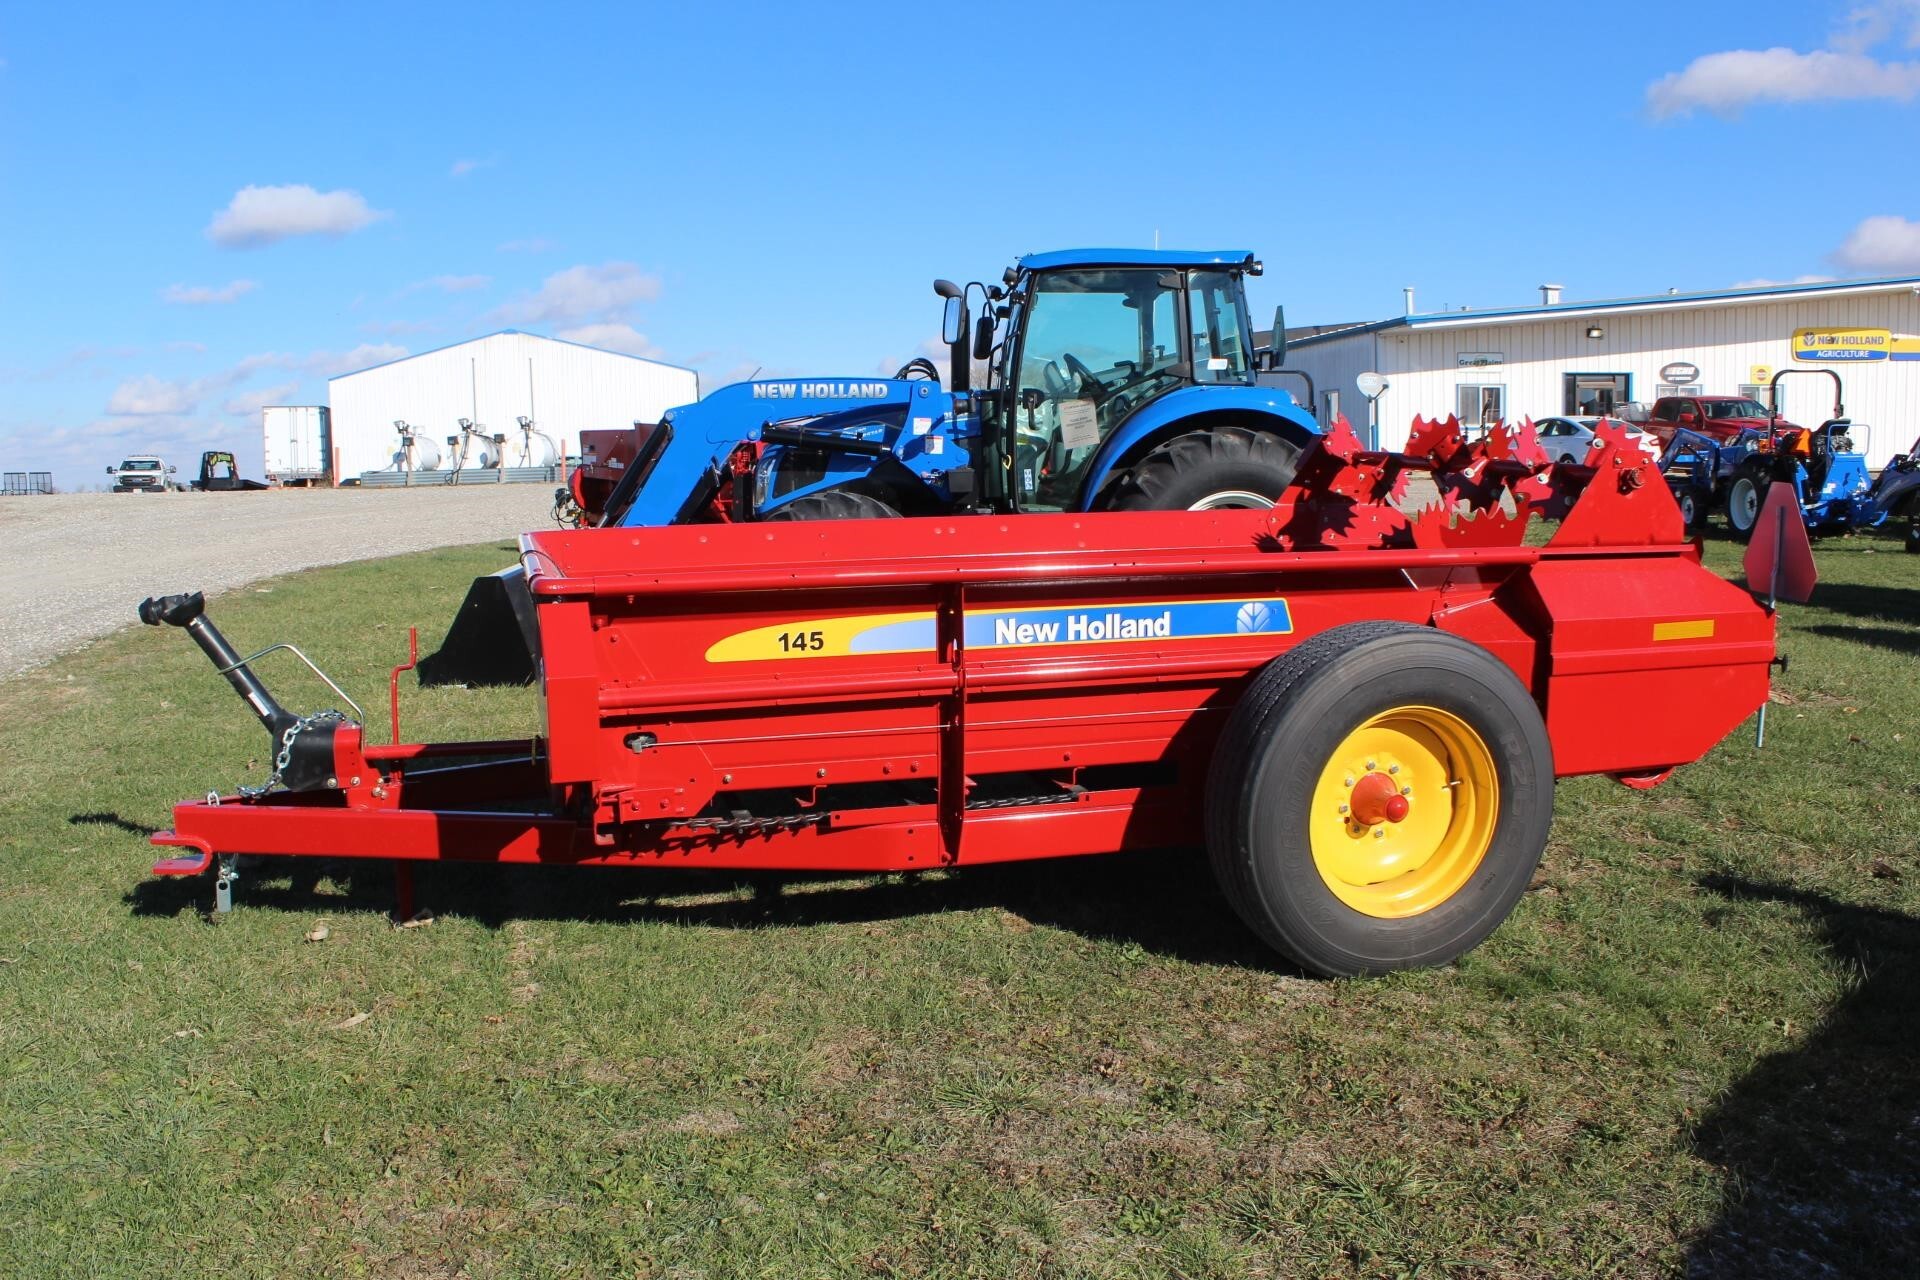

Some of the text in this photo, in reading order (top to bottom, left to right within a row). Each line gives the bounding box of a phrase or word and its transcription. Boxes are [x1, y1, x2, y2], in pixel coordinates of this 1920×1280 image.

[1817, 335, 1884, 345] NEW HOLLAND
[1816, 350, 1869, 358] AGRICULTURE
[753, 383, 888, 399] NEW HOLLAND
[995, 611, 1171, 644] New Holland
[778, 631, 824, 652] 145
